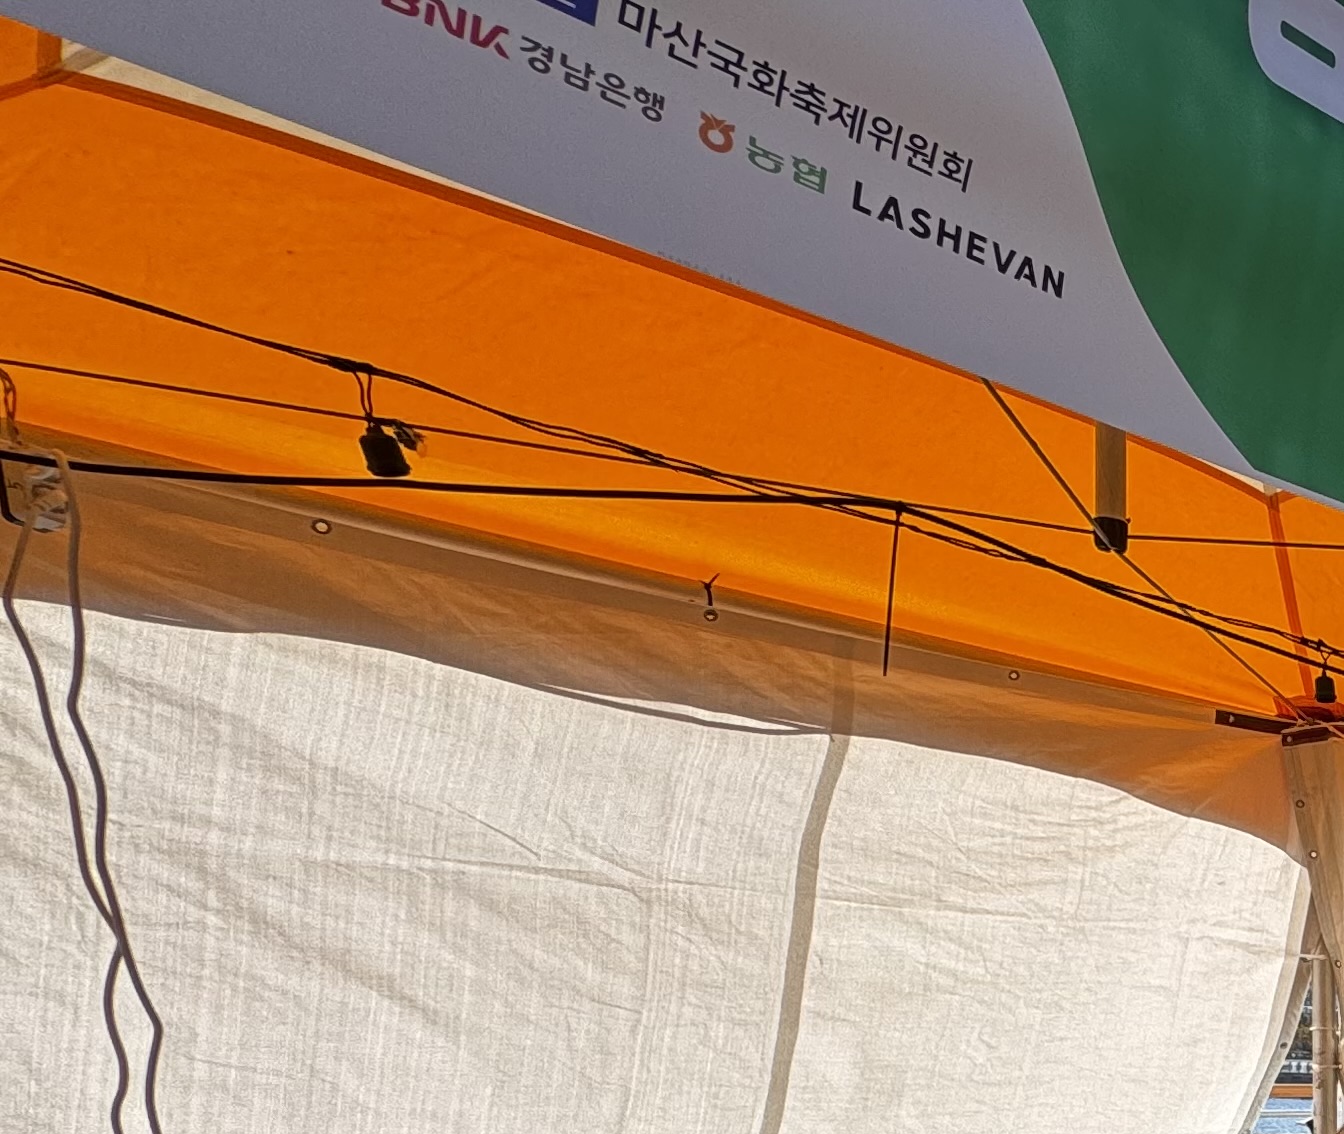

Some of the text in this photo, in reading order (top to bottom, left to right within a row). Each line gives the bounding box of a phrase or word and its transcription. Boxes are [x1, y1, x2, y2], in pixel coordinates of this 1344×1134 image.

[519, 35, 667, 123] 경남은행
[617, 0, 974, 193] 마산국화축제위원회
[745, 135, 828, 195] 농협
[851, 179, 1066, 300] LASHEVAN
